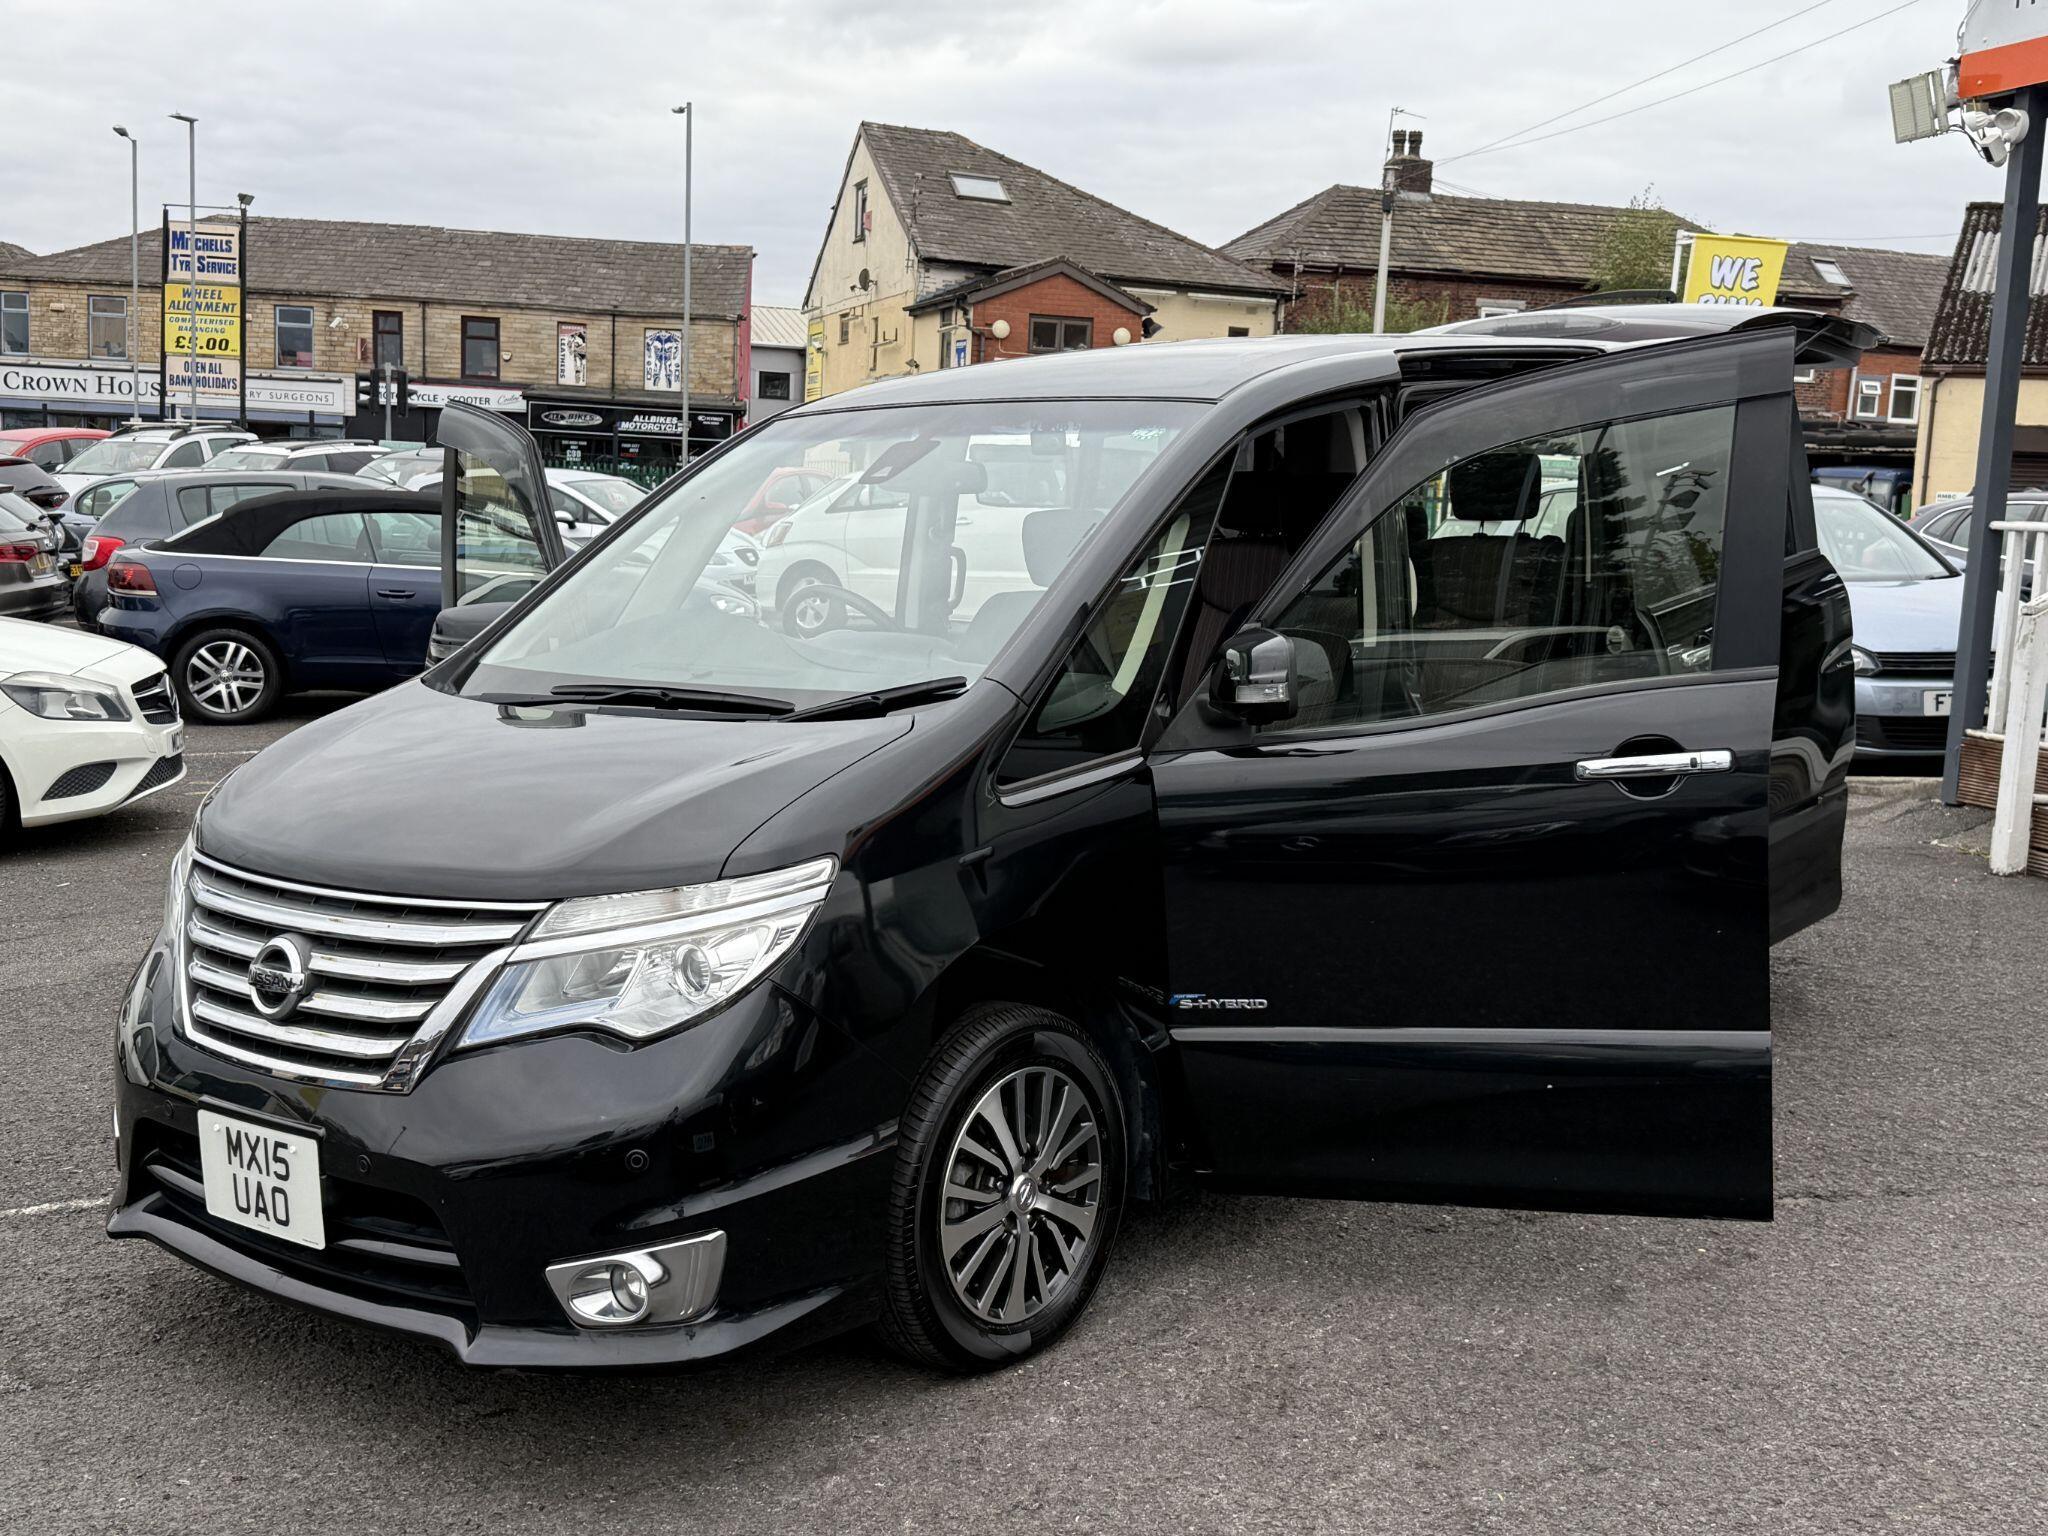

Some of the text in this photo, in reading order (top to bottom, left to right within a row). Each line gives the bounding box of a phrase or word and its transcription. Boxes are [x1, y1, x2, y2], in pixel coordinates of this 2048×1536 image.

[171, 230, 233, 253] MICHELLS
[171, 254, 237, 275] TYR SERVICE
[1711, 254, 1763, 292] WE
[182, 288, 223, 300] WHEEL
[177, 325, 225, 334] BANCING
[208, 362, 223, 375] ALL
[3, 371, 176, 397] CROWN HOUS
[169, 374, 238, 390] BANK HOLIDAYS
[269, 391, 330, 403] SURGEONS
[620, 421, 690, 432] MOTORCYCLE
[632, 414, 679, 425] ALLBIKES
[1179, 998, 1268, 1009] S-HYBRID
[225, 1126, 290, 1182] MX15
[232, 1172, 290, 1227] UAO
